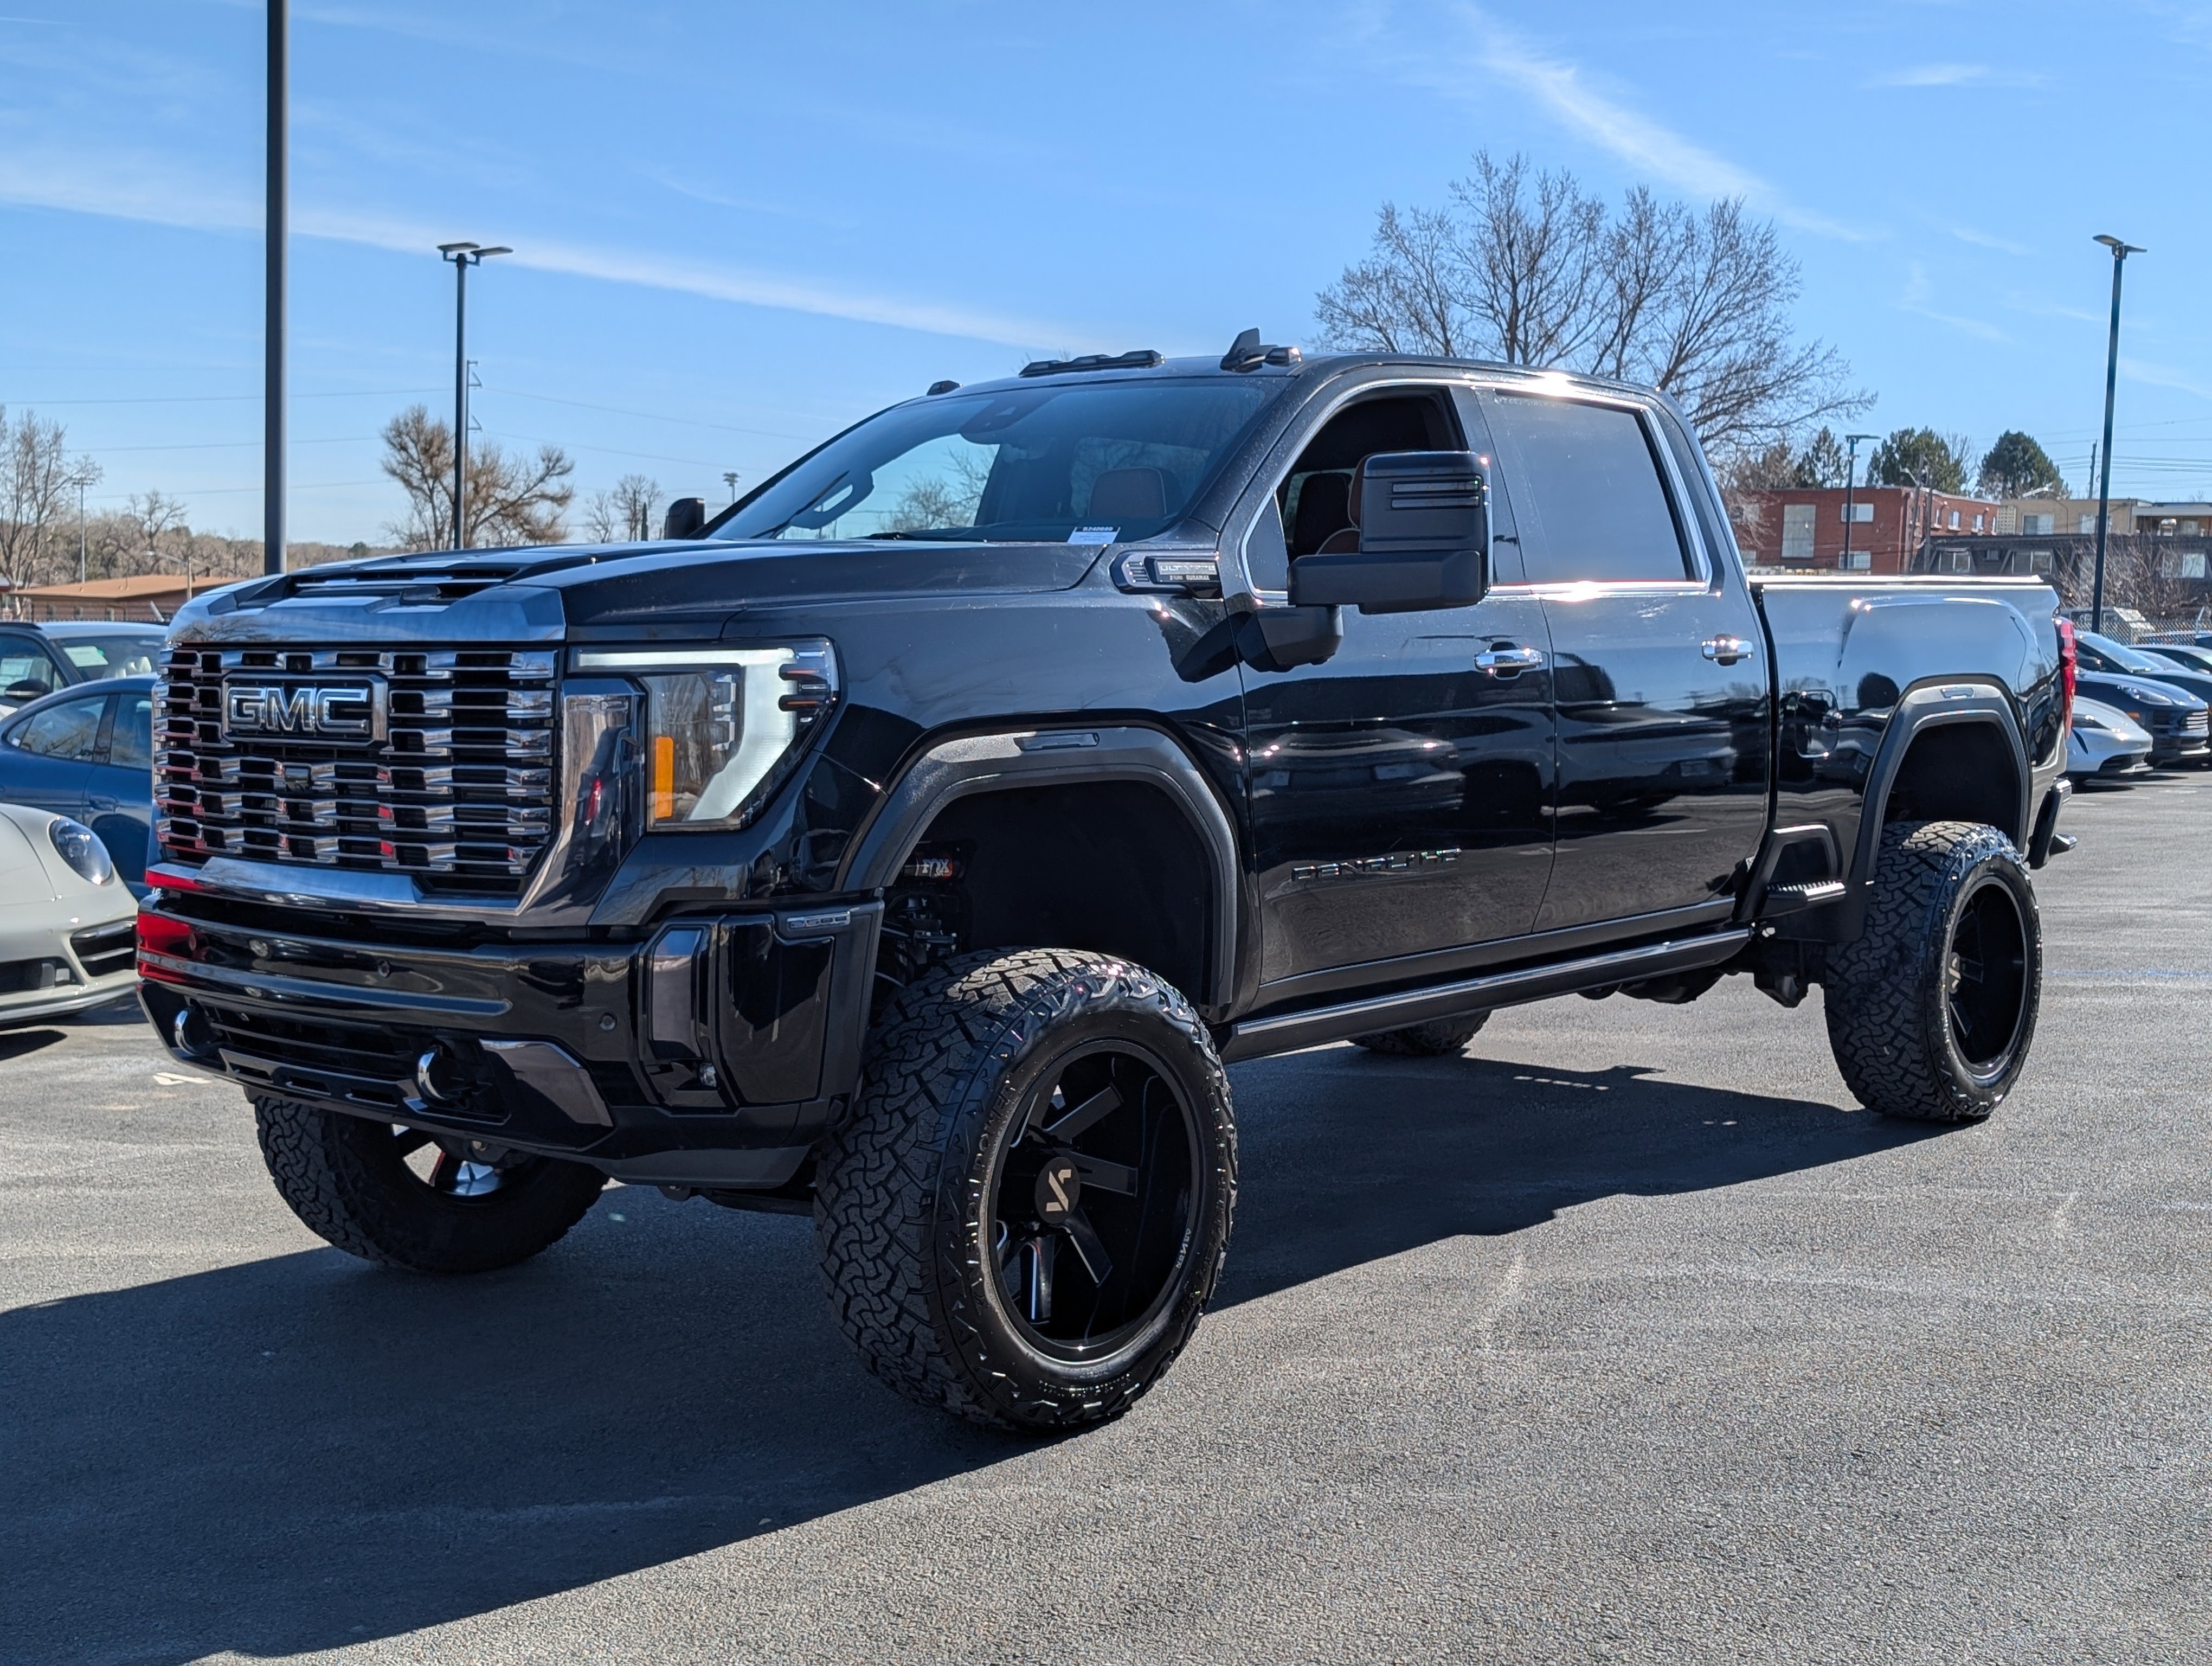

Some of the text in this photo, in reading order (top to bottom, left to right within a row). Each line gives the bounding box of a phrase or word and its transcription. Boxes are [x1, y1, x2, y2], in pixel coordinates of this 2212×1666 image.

[227, 687, 369, 733] GMC
[922, 858, 950, 877] FOX
[973, 1076, 1016, 1171] POWER
